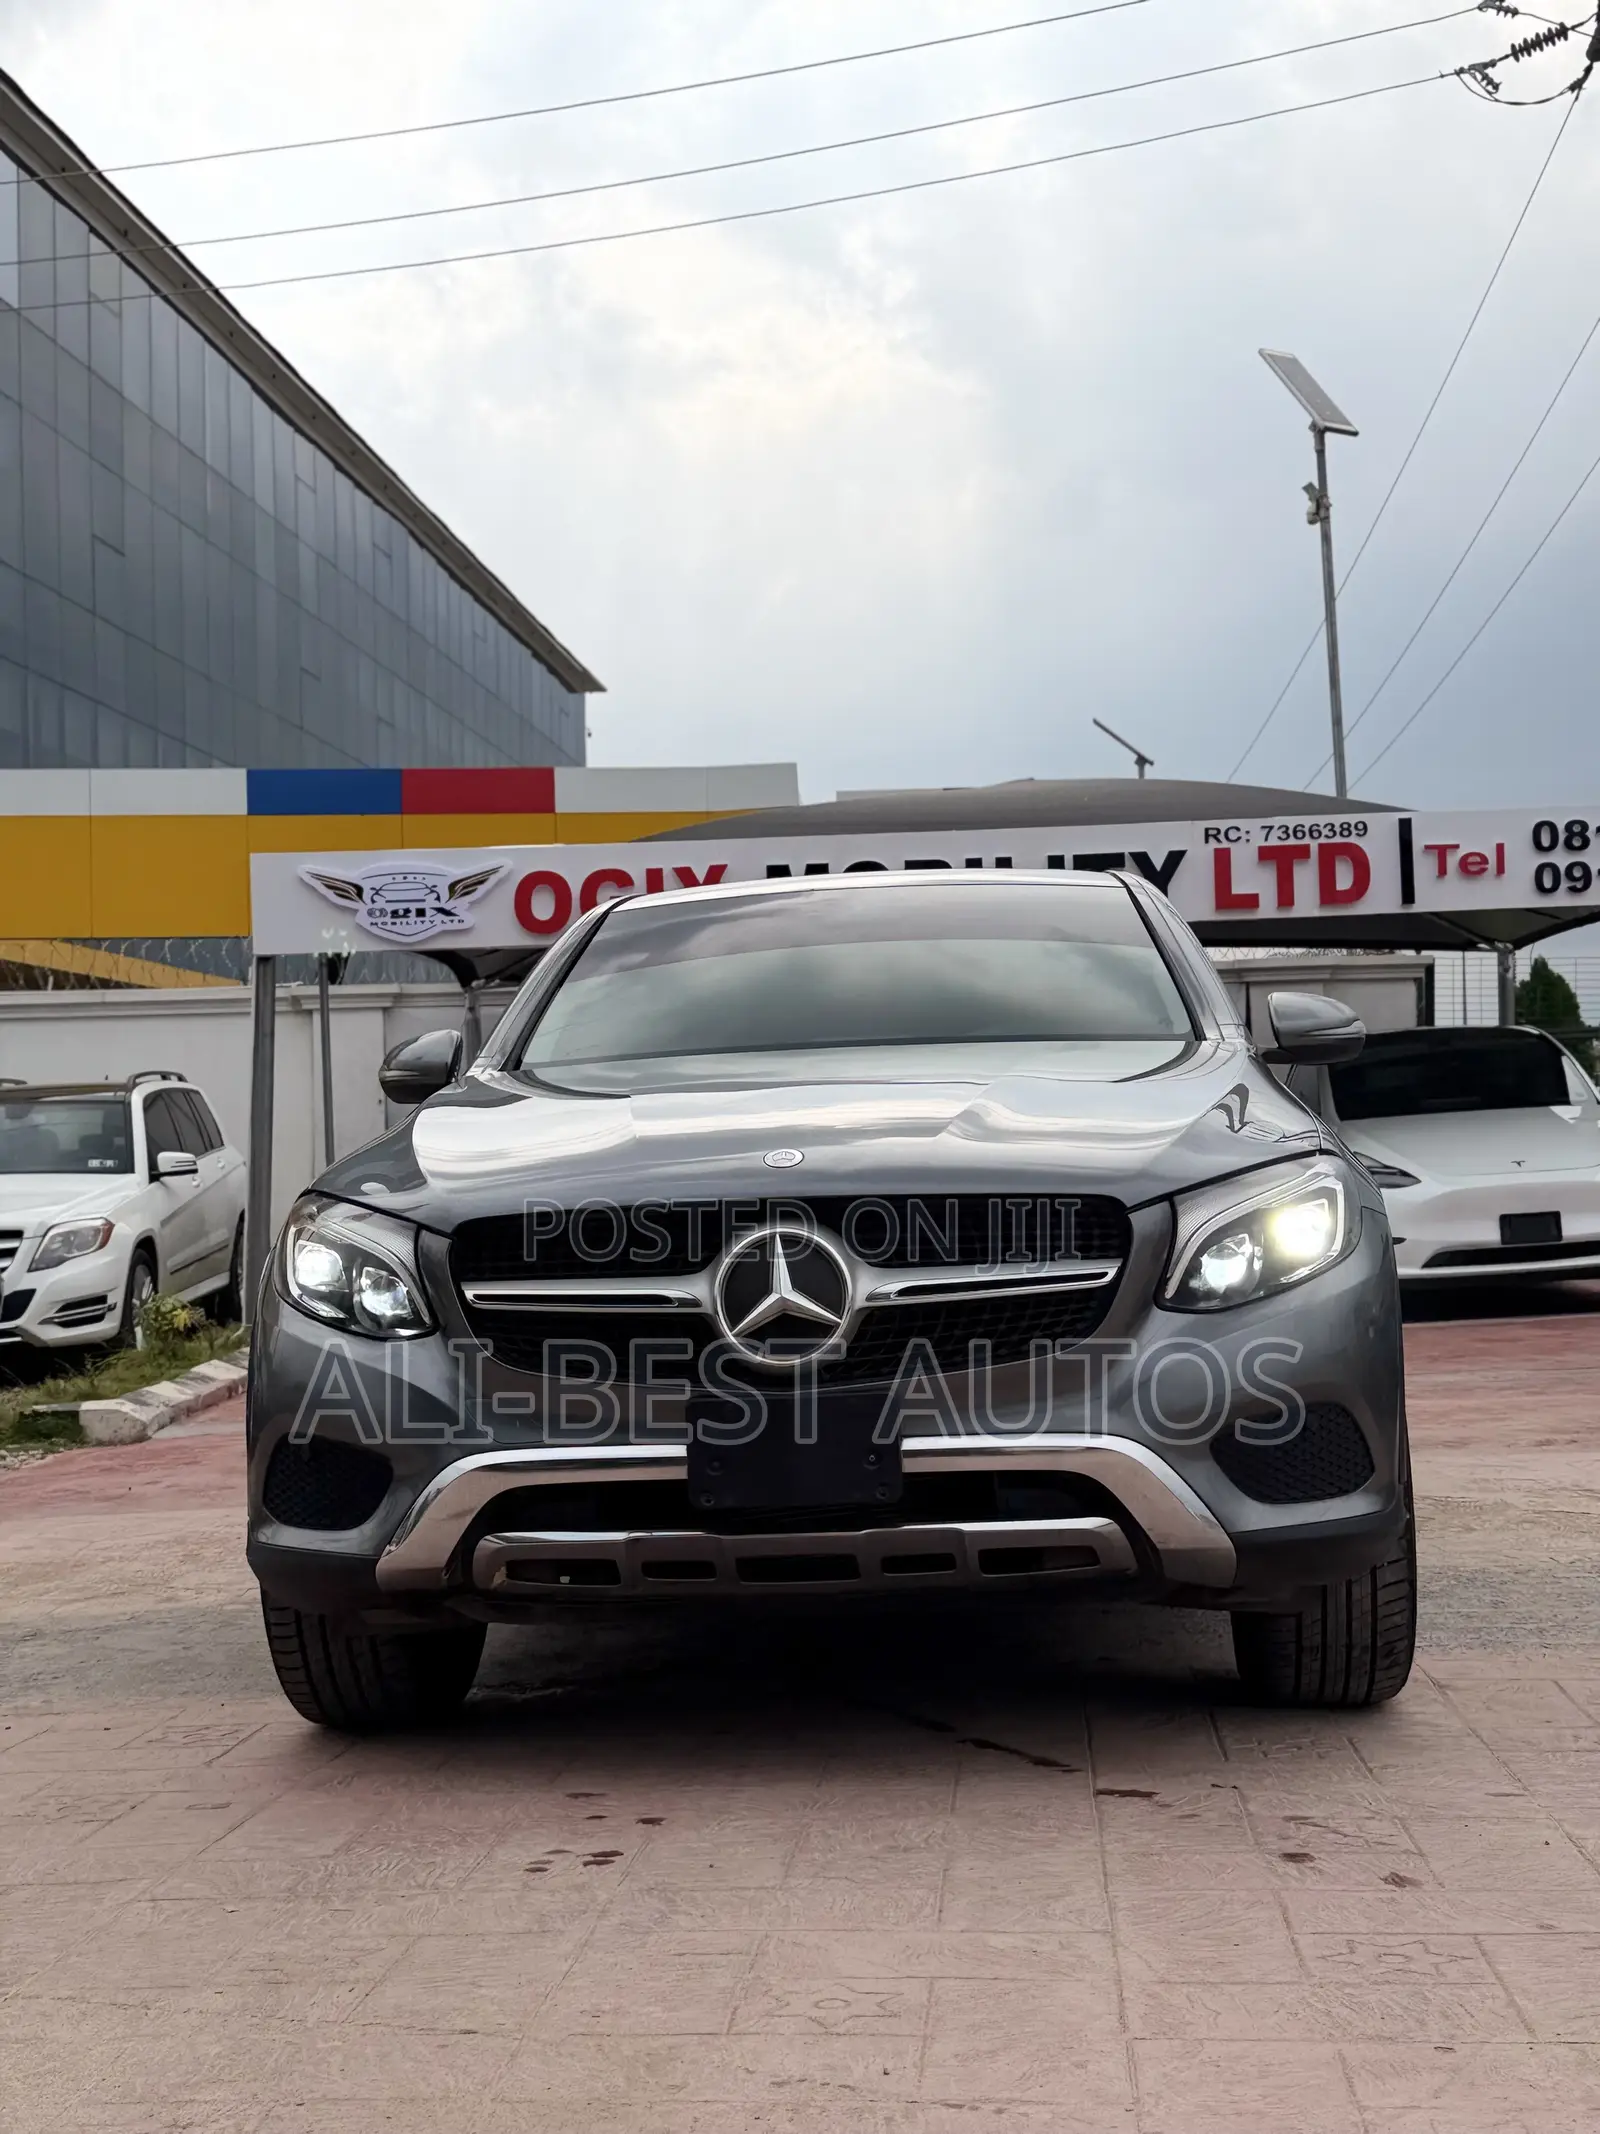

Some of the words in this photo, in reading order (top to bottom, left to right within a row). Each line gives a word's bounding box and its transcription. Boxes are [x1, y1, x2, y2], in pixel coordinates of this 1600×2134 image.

[1204, 825, 1251, 844] RC:
[1260, 820, 1369, 842] 7366389
[1532, 818, 1600, 853] 08
[1213, 842, 1371, 912] LTD
[1423, 843, 1506, 878] Tel
[1534, 861, 1600, 894] 09
